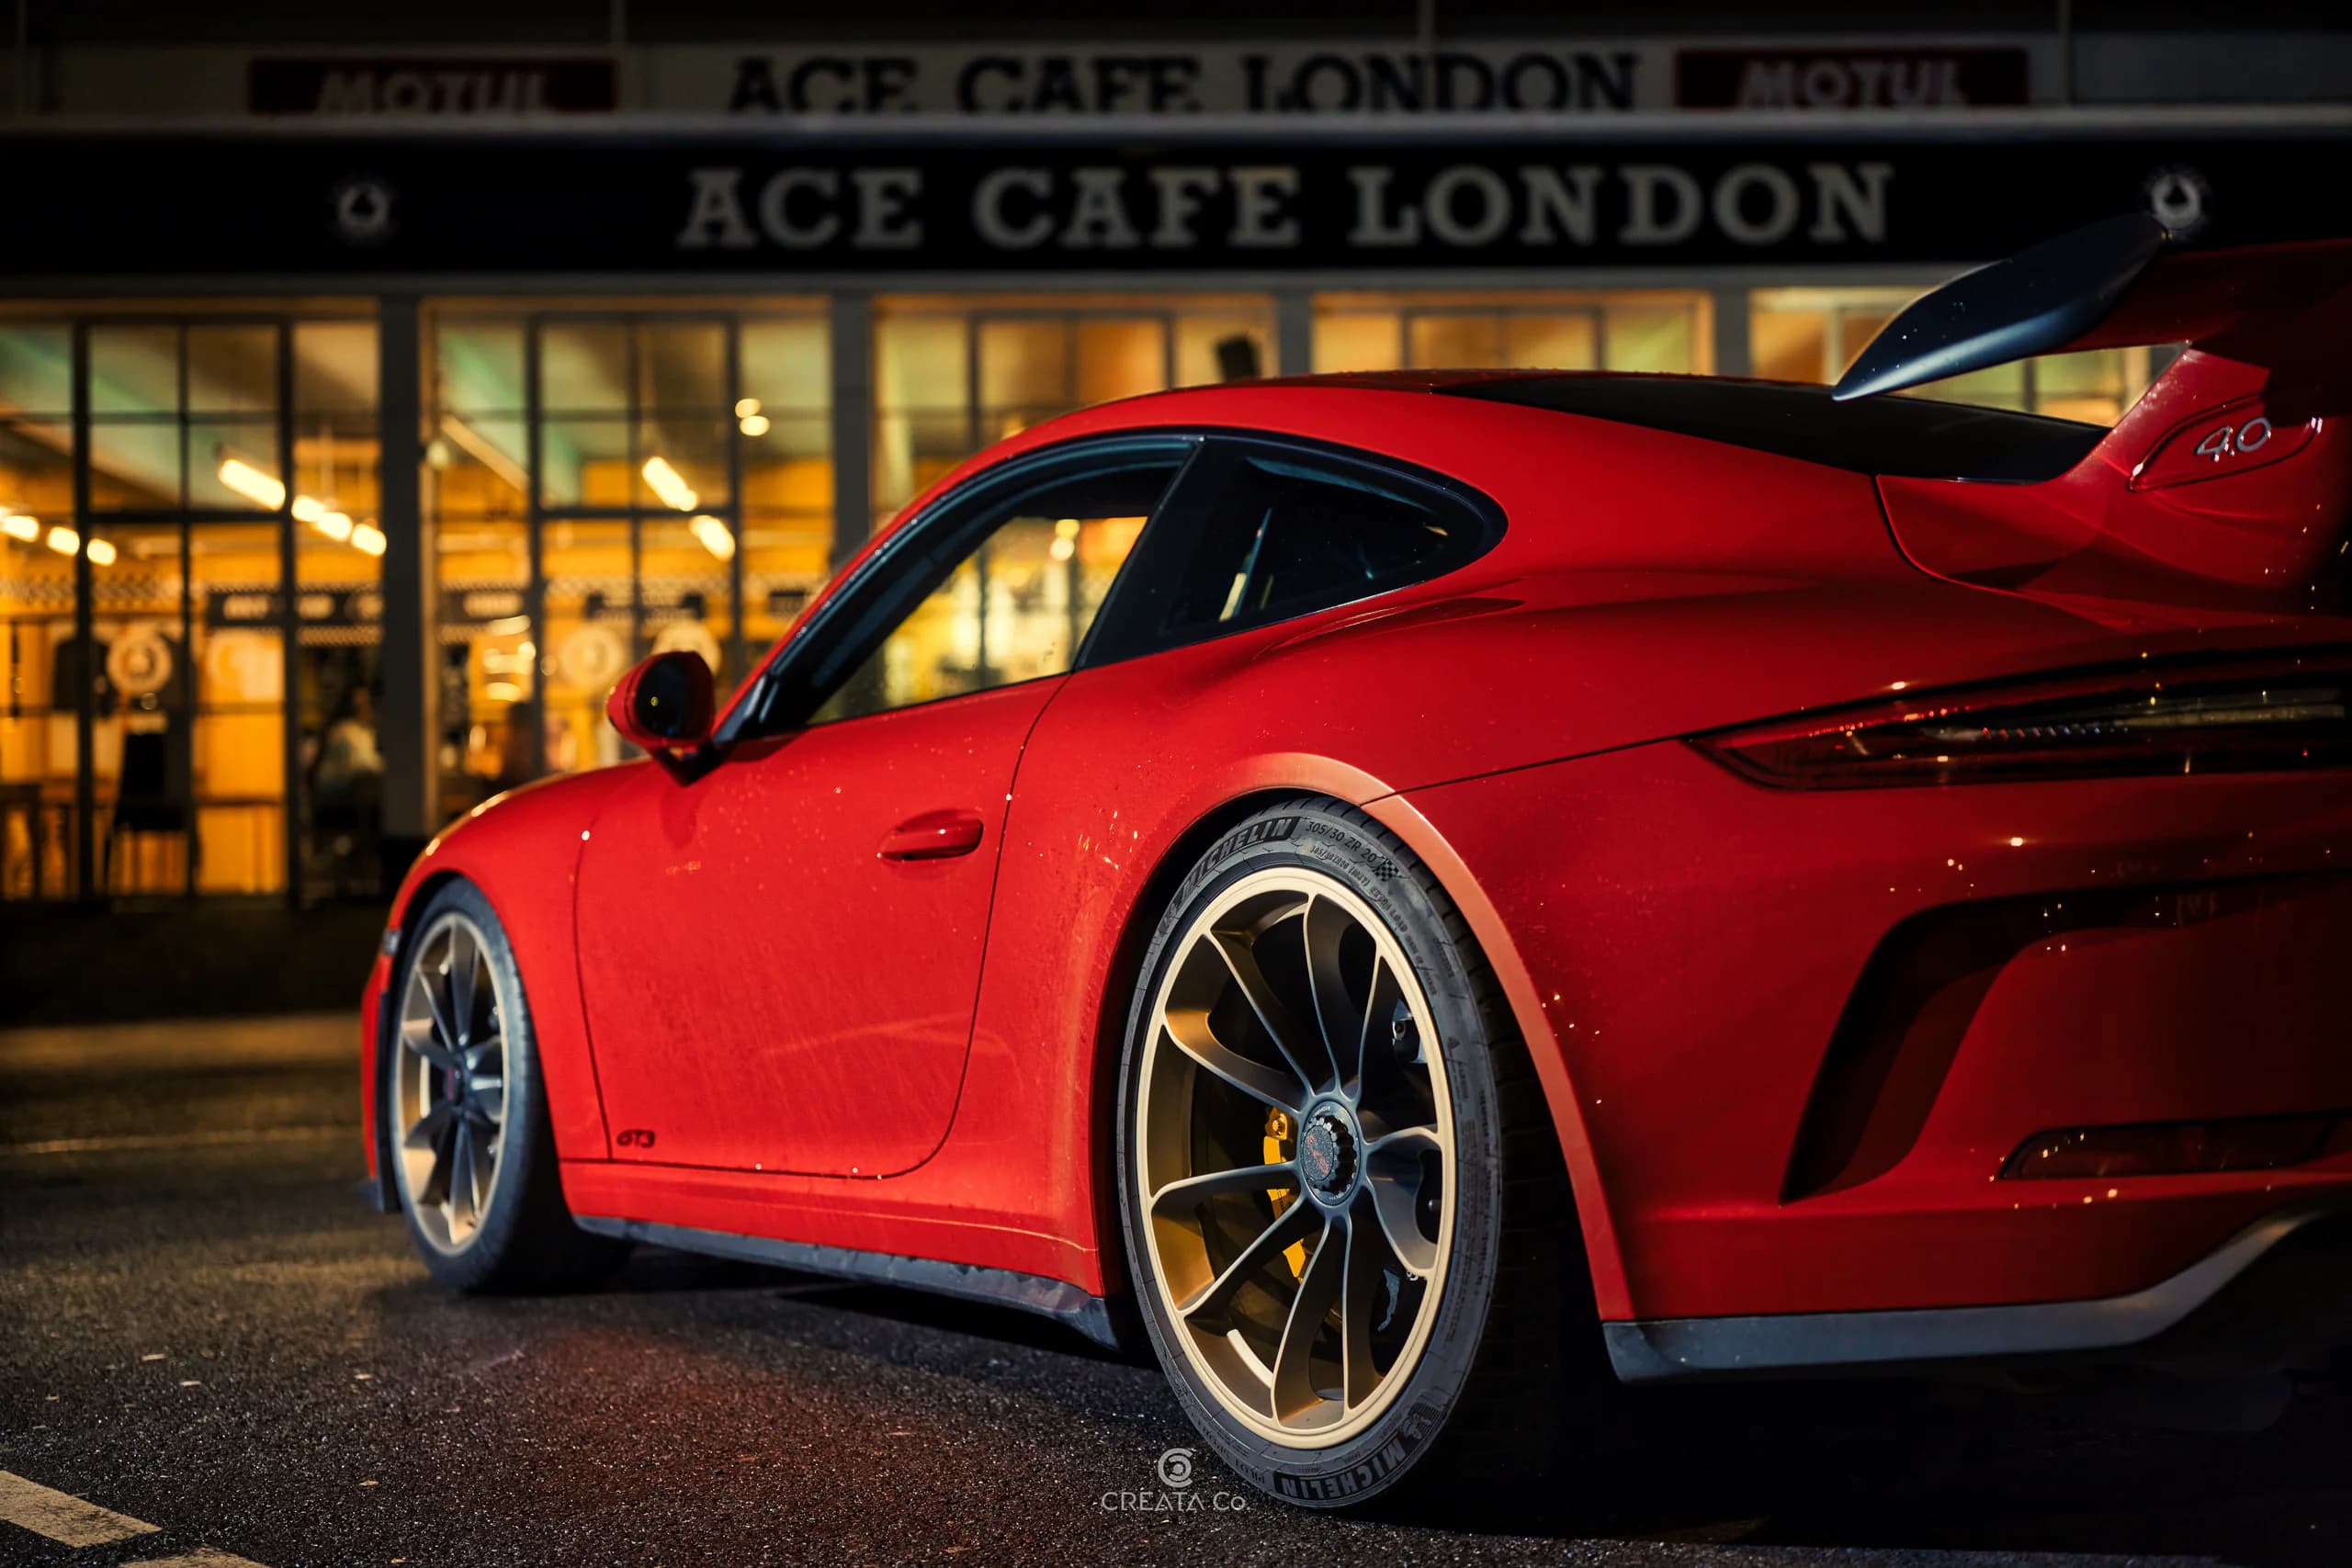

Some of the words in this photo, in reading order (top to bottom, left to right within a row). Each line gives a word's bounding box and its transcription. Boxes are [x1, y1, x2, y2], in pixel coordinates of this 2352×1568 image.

[314, 68, 548, 110] MOTUL
[731, 56, 917, 111] ACE
[958, 56, 1203, 111] CAFE
[1243, 53, 1639, 110] LONDON
[1737, 57, 1972, 106] MOTUL
[673, 164, 924, 250] ACE
[969, 164, 1303, 250] CAFE
[1346, 163, 1895, 249] LONDON
[1306, 821, 1345, 841] 305/30
[1344, 837, 1362, 852] ZR
[1361, 848, 1377, 863] 20
[1281, 1437, 1407, 1500] MICHELIN
